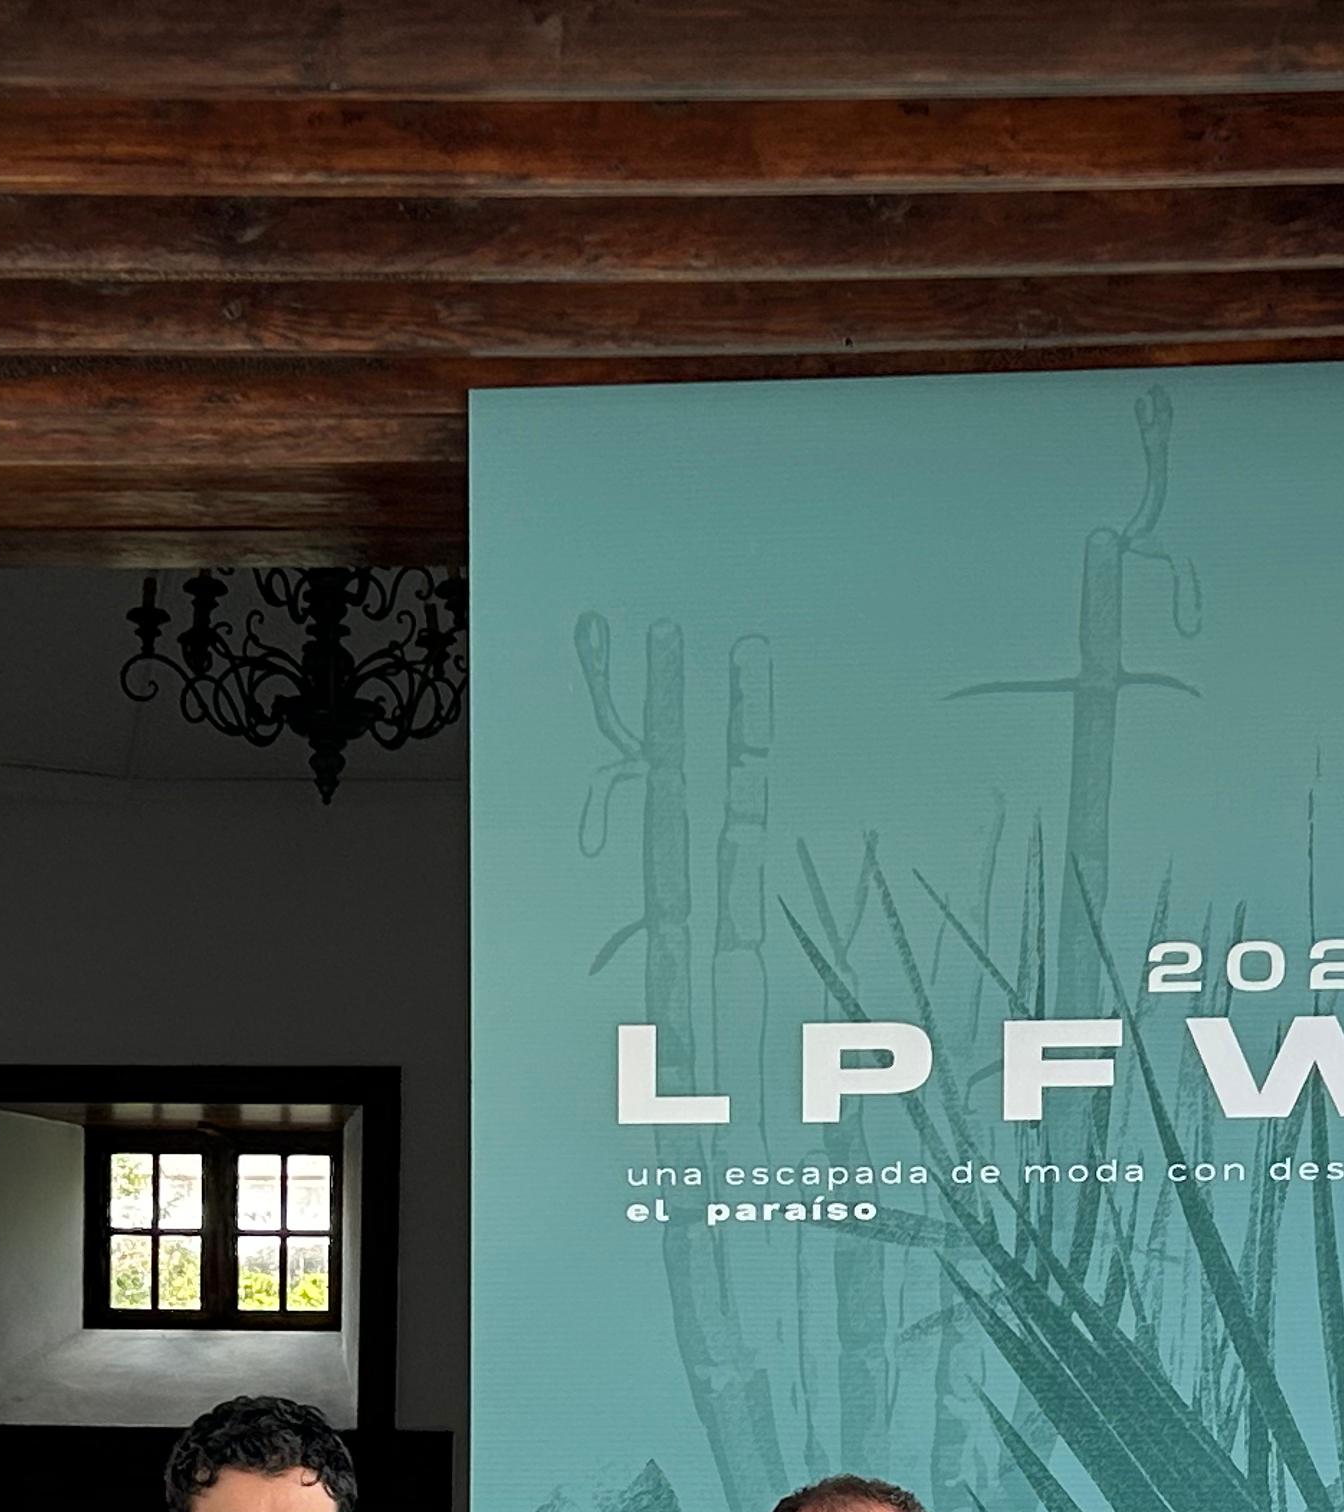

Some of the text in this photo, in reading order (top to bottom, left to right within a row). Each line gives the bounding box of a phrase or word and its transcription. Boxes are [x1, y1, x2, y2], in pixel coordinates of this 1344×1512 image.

[627, 1167, 702, 1187] una
[725, 1160, 928, 1191] escapada
[951, 1160, 1001, 1184] de
[1024, 1159, 1144, 1183] moda
[1167, 1162, 1245, 1182] con
[626, 1195, 877, 1226] el paraíso
